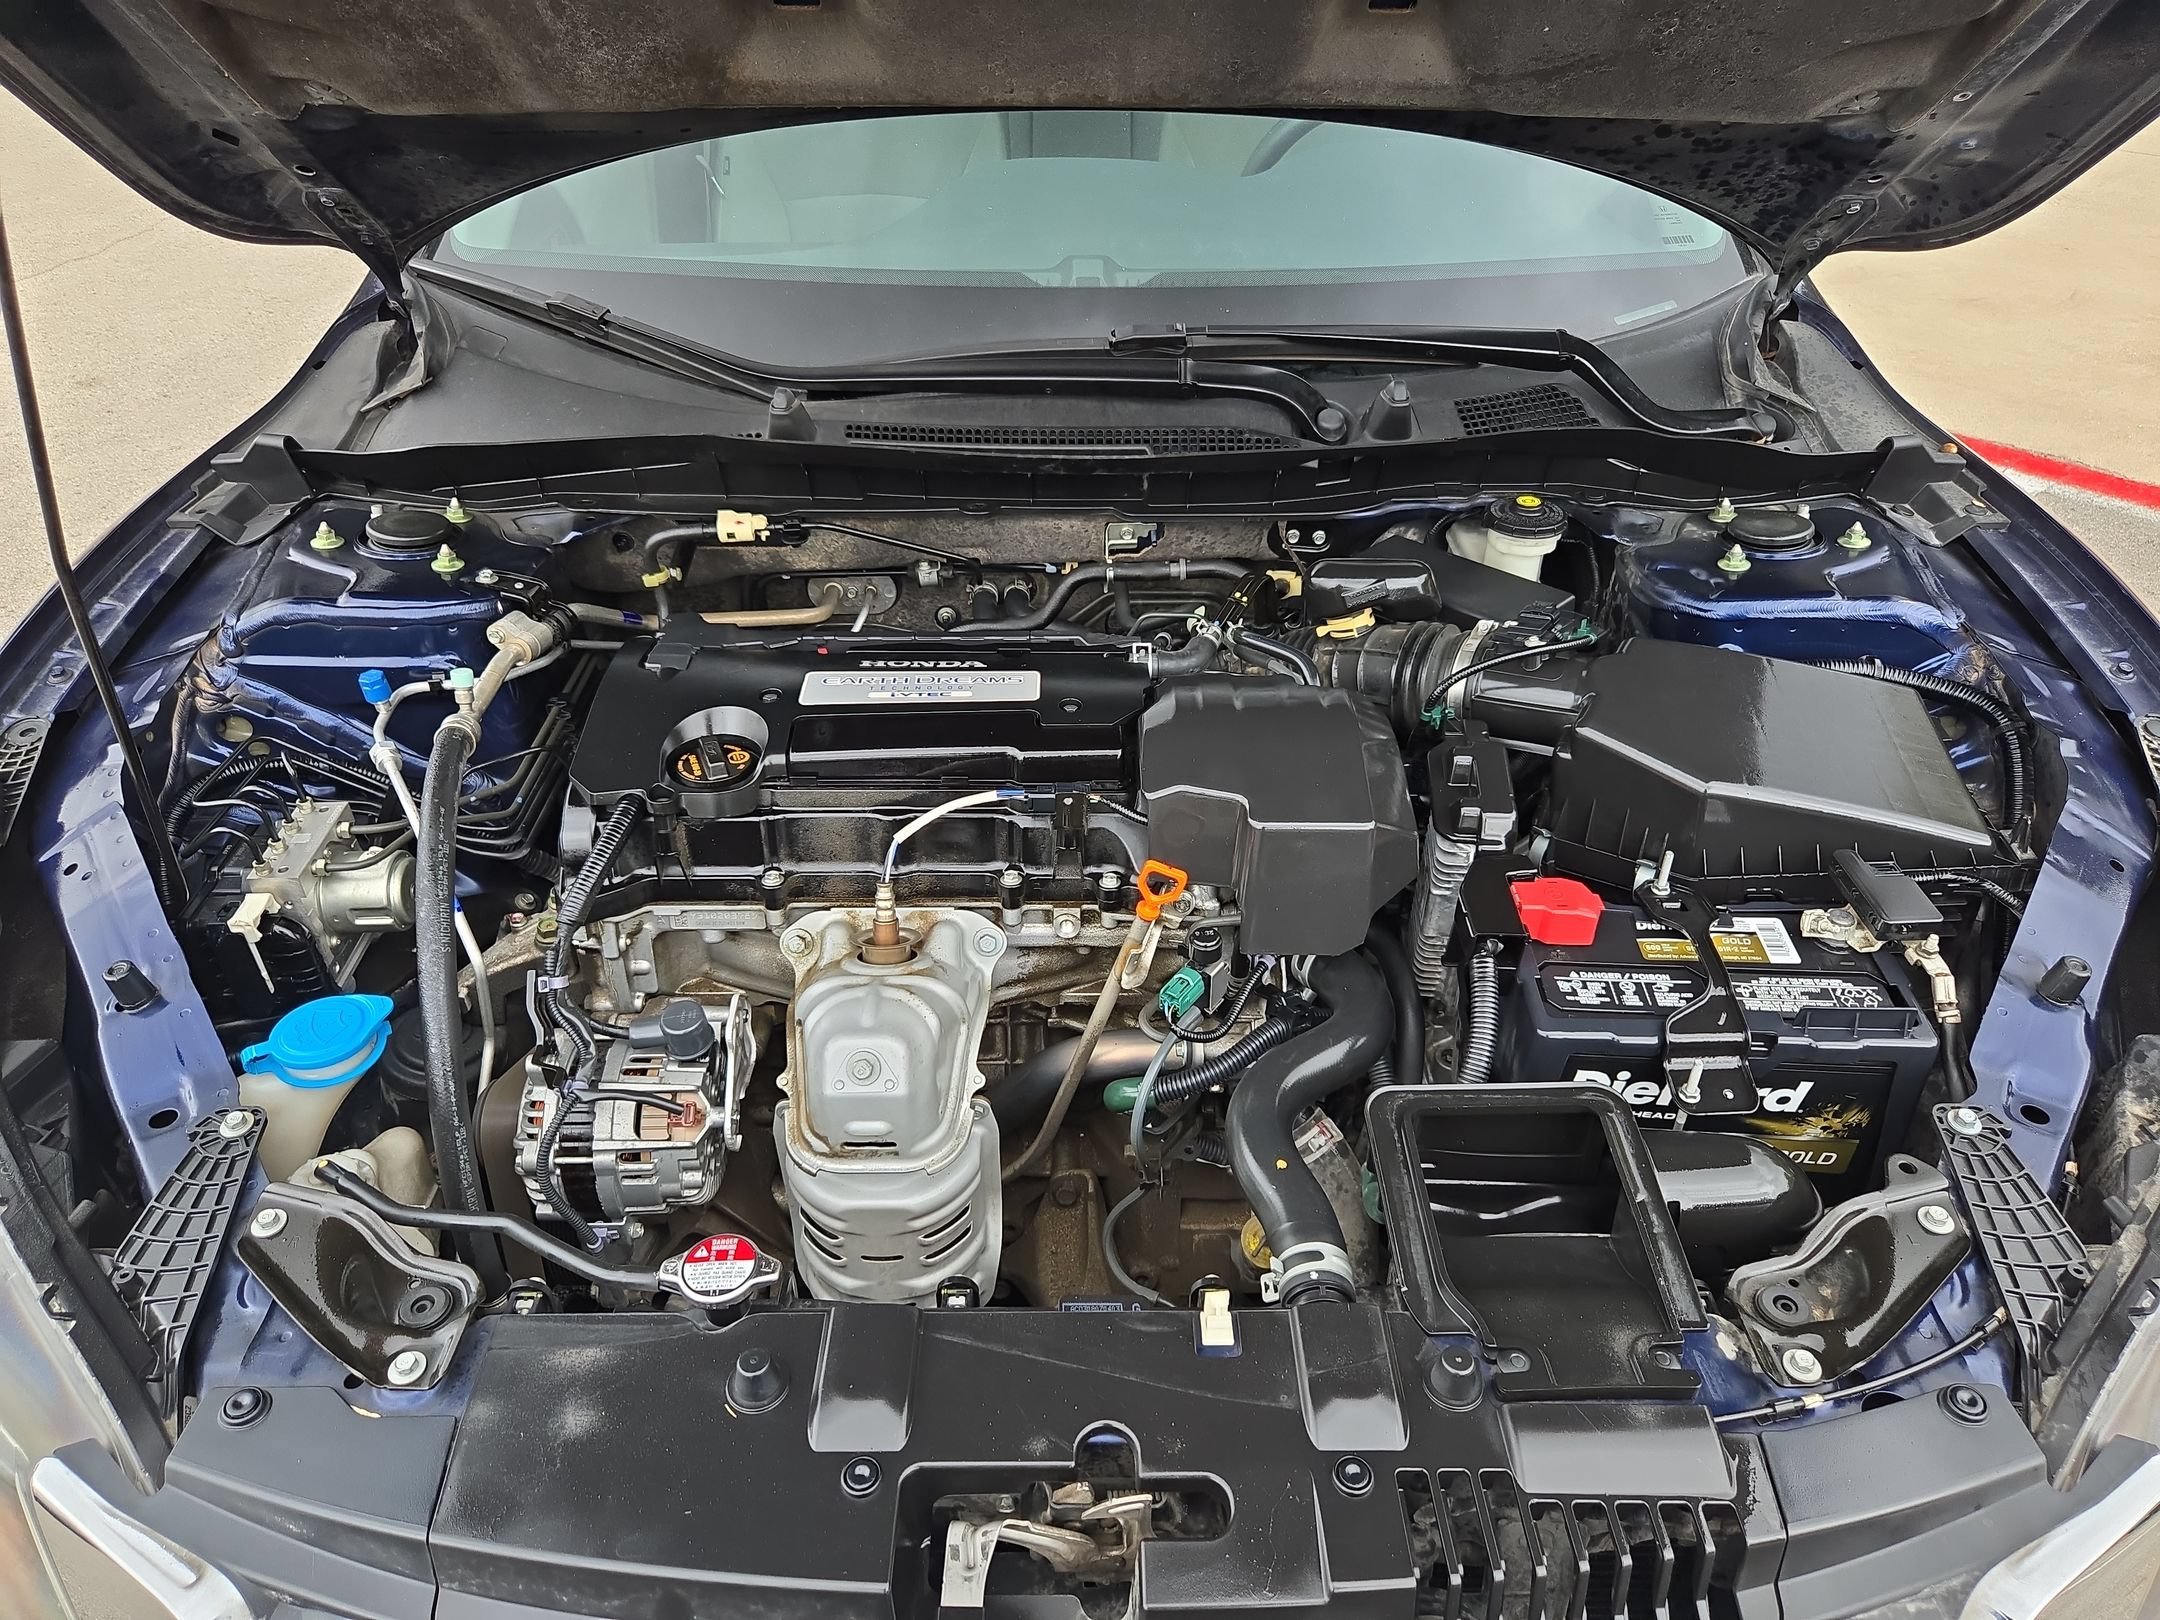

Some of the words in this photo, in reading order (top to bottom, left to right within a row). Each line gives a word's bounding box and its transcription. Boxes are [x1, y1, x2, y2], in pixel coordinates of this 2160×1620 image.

[859, 660, 988, 668] HONDA
[821, 676, 909, 685] EARTH
[914, 675, 1024, 685] DREAMS
[1721, 937, 1752, 945] GOLD
[1579, 971, 1622, 979] DANGER
[1632, 973, 1671, 981] POISON
[1573, 1069, 1814, 1113] Dierd
[1632, 1110, 1677, 1120] HEAD
[1781, 1150, 1837, 1166] OLD
[712, 1238, 739, 1246] DANGER
